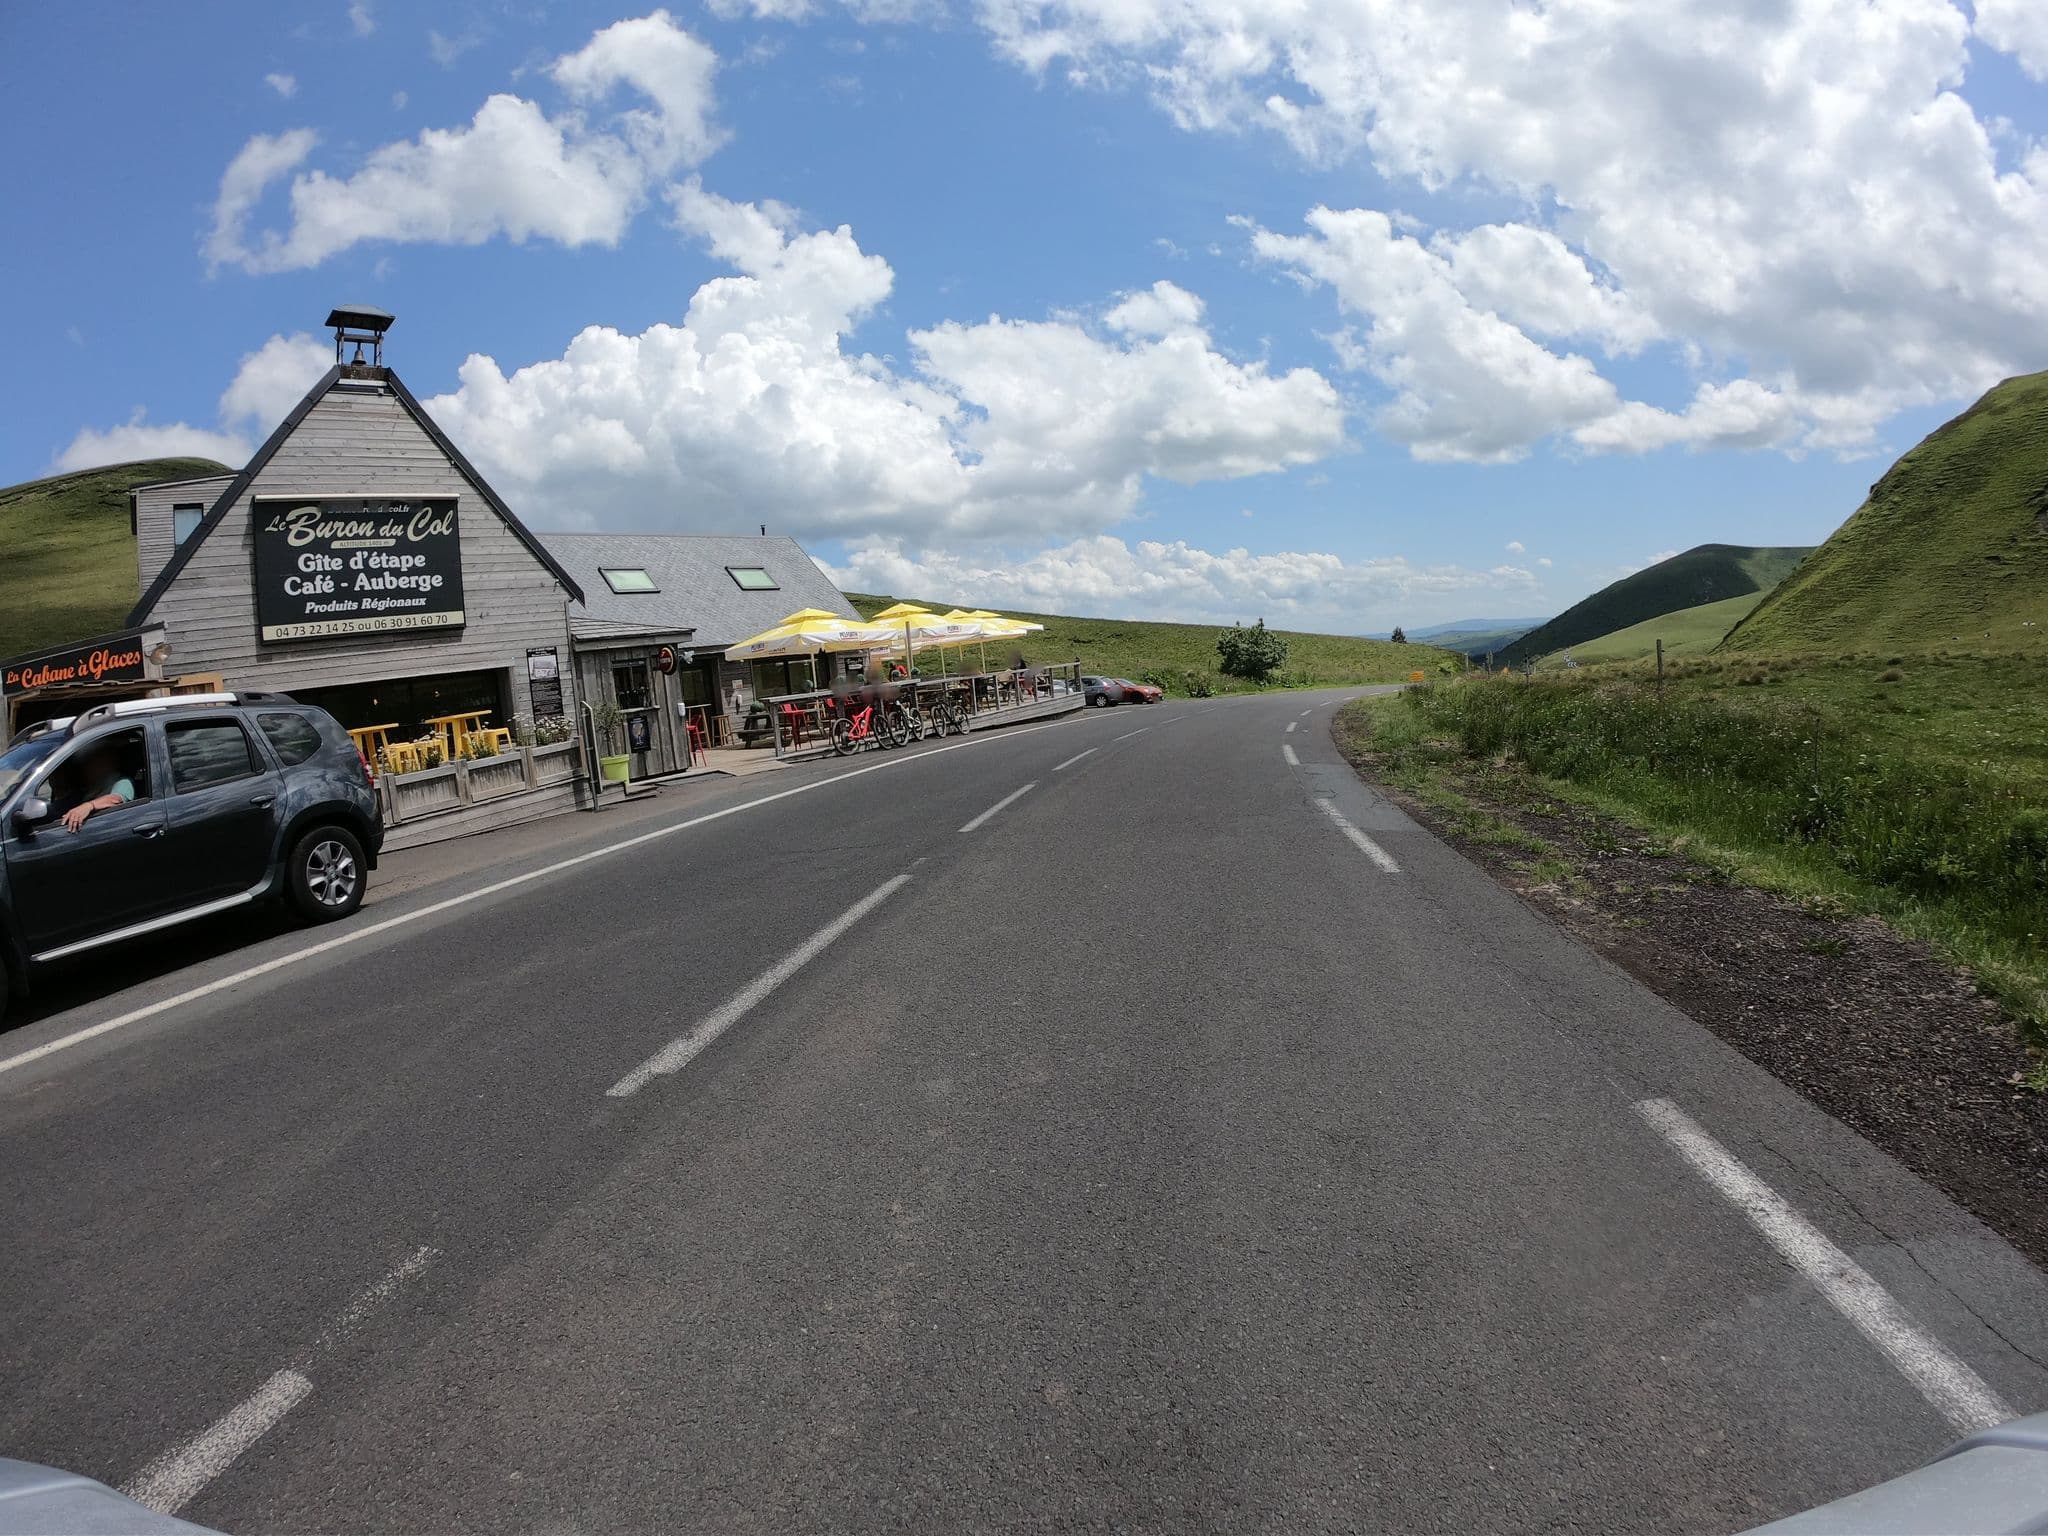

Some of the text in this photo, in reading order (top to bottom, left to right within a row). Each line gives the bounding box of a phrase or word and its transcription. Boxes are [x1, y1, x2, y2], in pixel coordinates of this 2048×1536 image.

[265, 506, 454, 547] Le Buron du Col
[297, 551, 426, 573] Gîte d'étape
[284, 575, 335, 597] Café
[354, 572, 443, 592] Auberge
[304, 596, 427, 614] Produits Régionaux
[276, 614, 448, 637] 04 73 22 14 25 ou 06 30 91 60 70
[6, 649, 141, 688] La Cabane à Glaces
